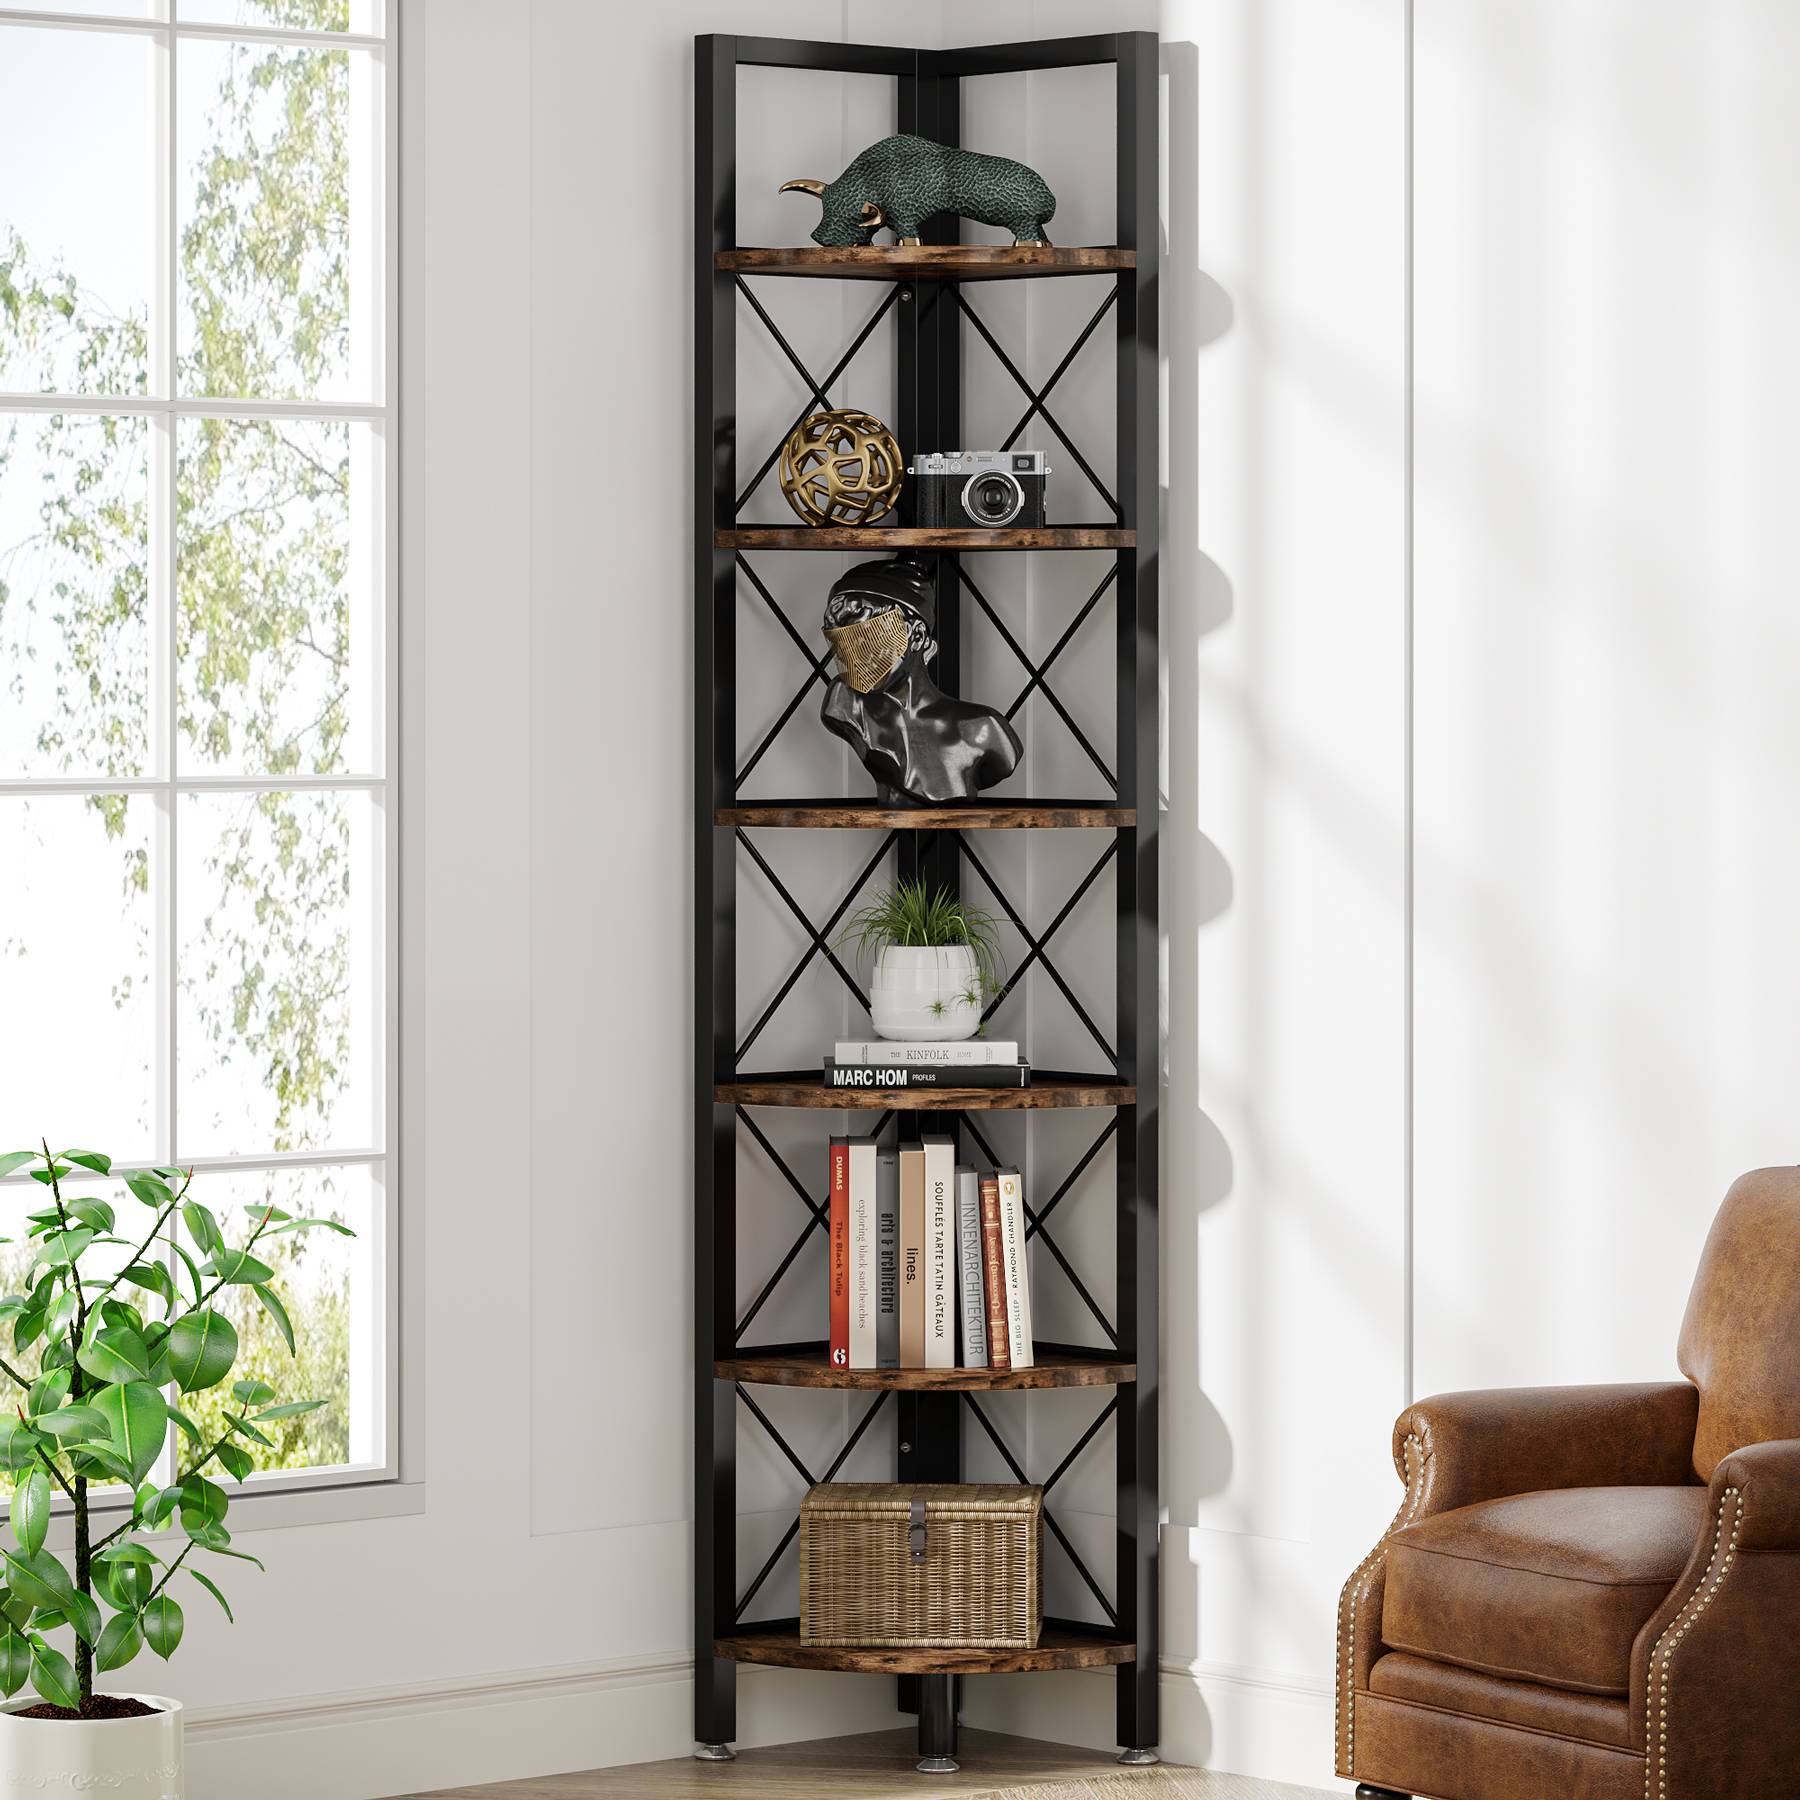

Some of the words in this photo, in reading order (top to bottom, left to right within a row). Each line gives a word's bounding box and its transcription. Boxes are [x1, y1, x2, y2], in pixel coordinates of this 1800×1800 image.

[906, 1049, 949, 1060] KINFOLK
[833, 1069, 873, 1086] MARC
[876, 1069, 907, 1086] HOM
[912, 1073, 936, 1082] PROFILES
[856, 1199, 868, 1242] exploring
[881, 1213, 895, 1233] arts
[1007, 1202, 1015, 1244] CHANDLER
[859, 1245, 868, 1269] black
[935, 1231, 944, 1260] TARTE
[906, 1248, 919, 1285] lines.
[935, 1262, 944, 1291] TATIN
[961, 1202, 985, 1355] INNENARCHITEKTUR
[1010, 1248, 1018, 1289] RAYMOND
[834, 1272, 843, 1296] Tulip
[859, 1271, 868, 1292] sand
[881, 1251, 896, 1314] architecture
[859, 1293, 868, 1329] beaches
[1013, 1301, 1021, 1321] SLEEP
